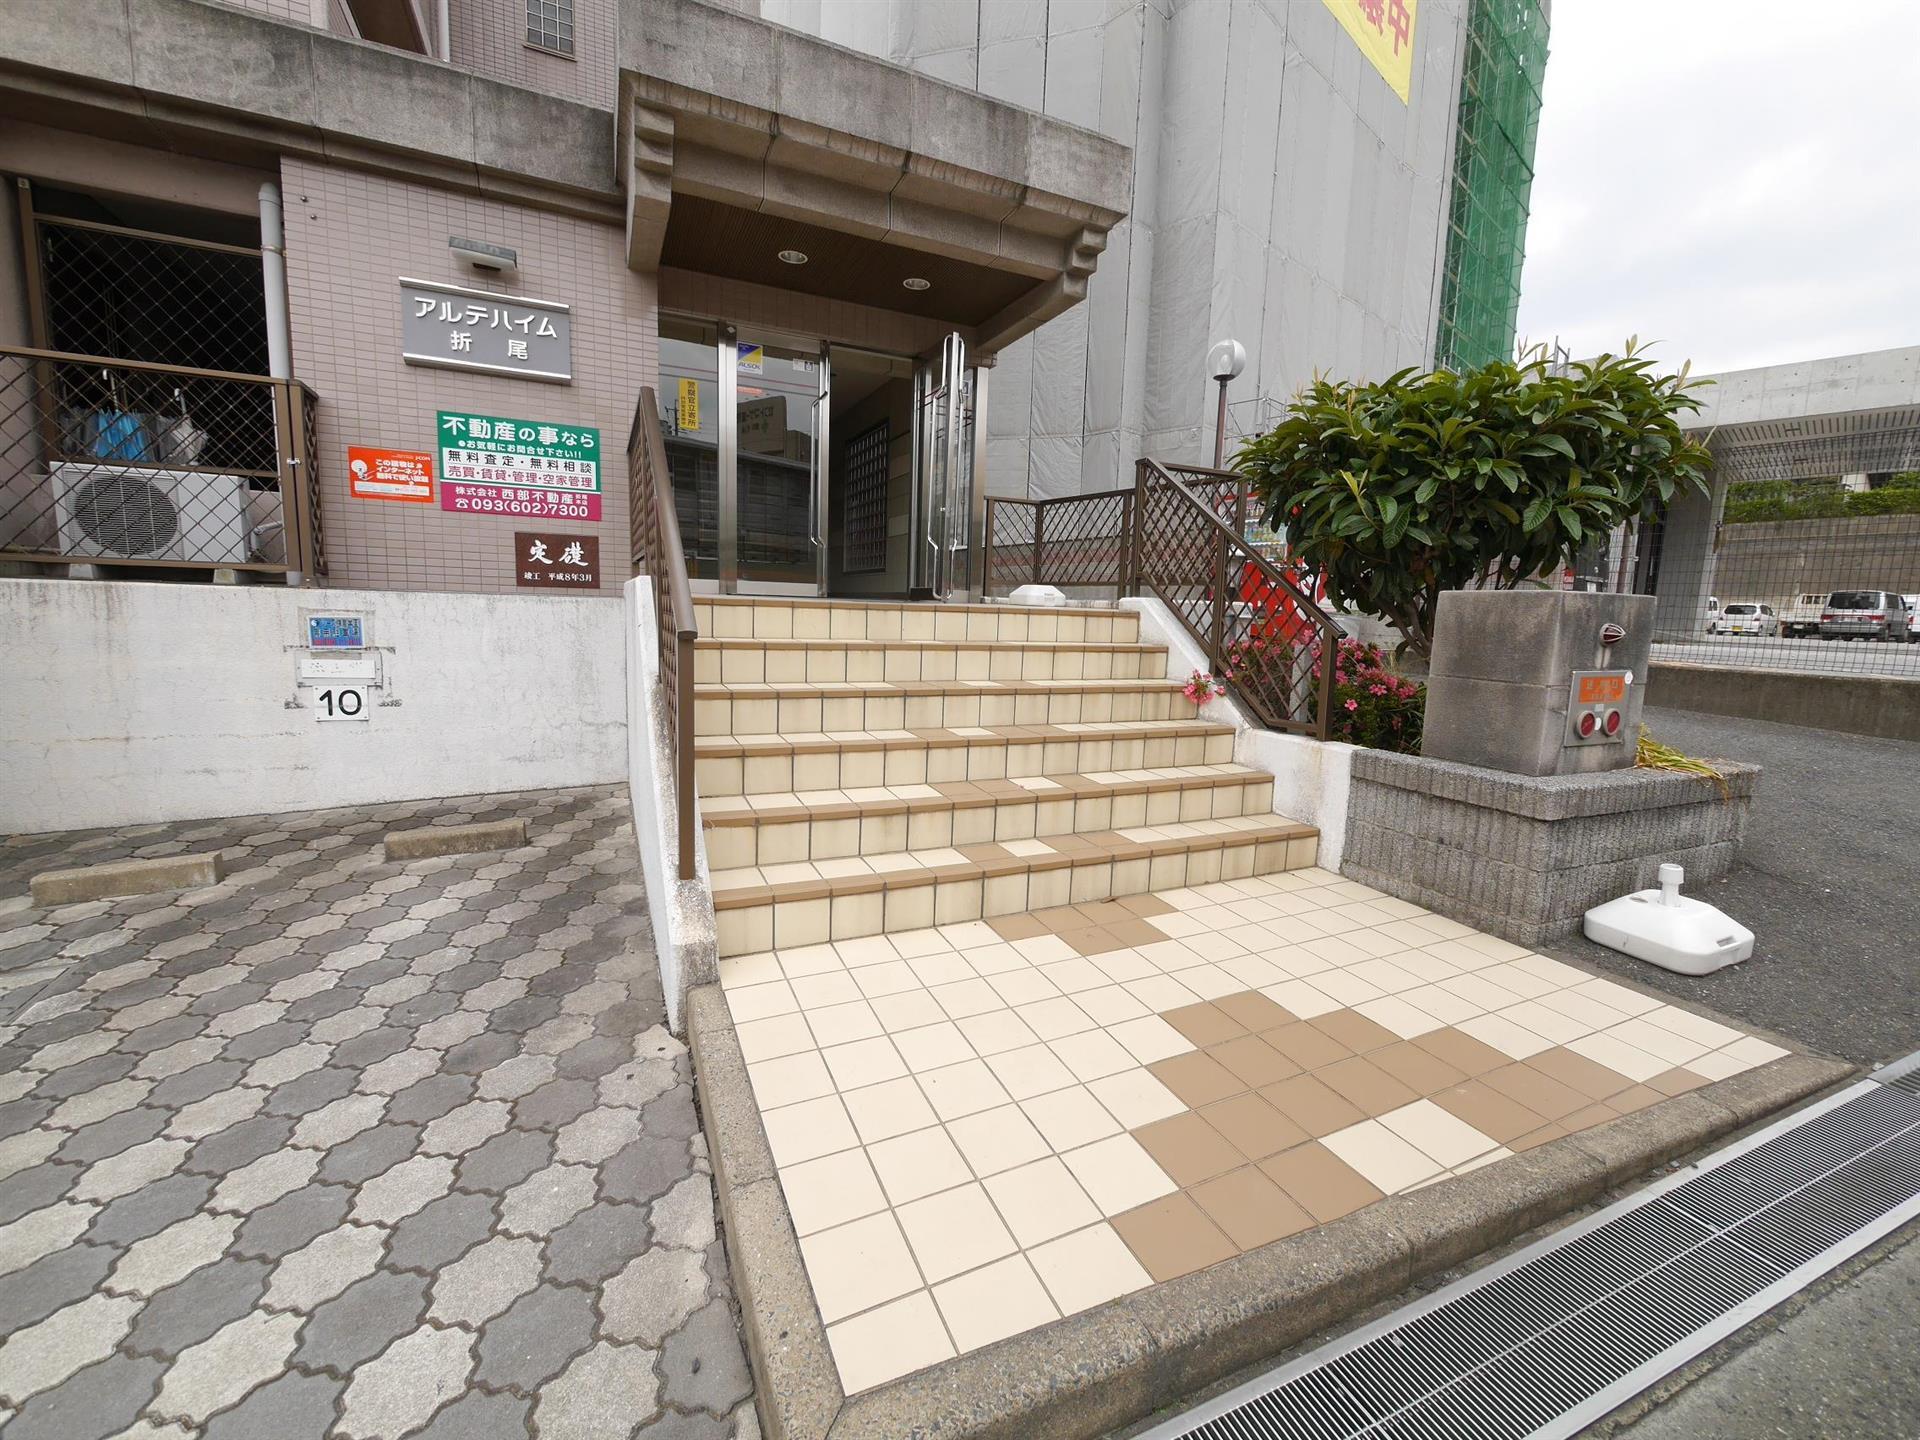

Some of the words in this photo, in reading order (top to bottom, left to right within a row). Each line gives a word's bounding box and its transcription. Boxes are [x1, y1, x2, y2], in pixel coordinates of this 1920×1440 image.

[414, 297, 557, 338] アルテハイム
[450, 330, 528, 360] 折尾
[442, 415, 594, 448] 不動産の事なら
[377, 465, 424, 475] インターネット
[448, 450, 592, 474] 無料査定・無料相談
[448, 465, 593, 489] 売買・賃貸・管理・空家管理
[455, 486, 497, 498] 株式会社
[501, 488, 574, 505] 西部不動産
[471, 498, 588, 517] 093(602)7300
[528, 539, 589, 566] 定礎
[547, 572, 592, 582] 平成8年3月
[319, 689, 362, 716] 10
